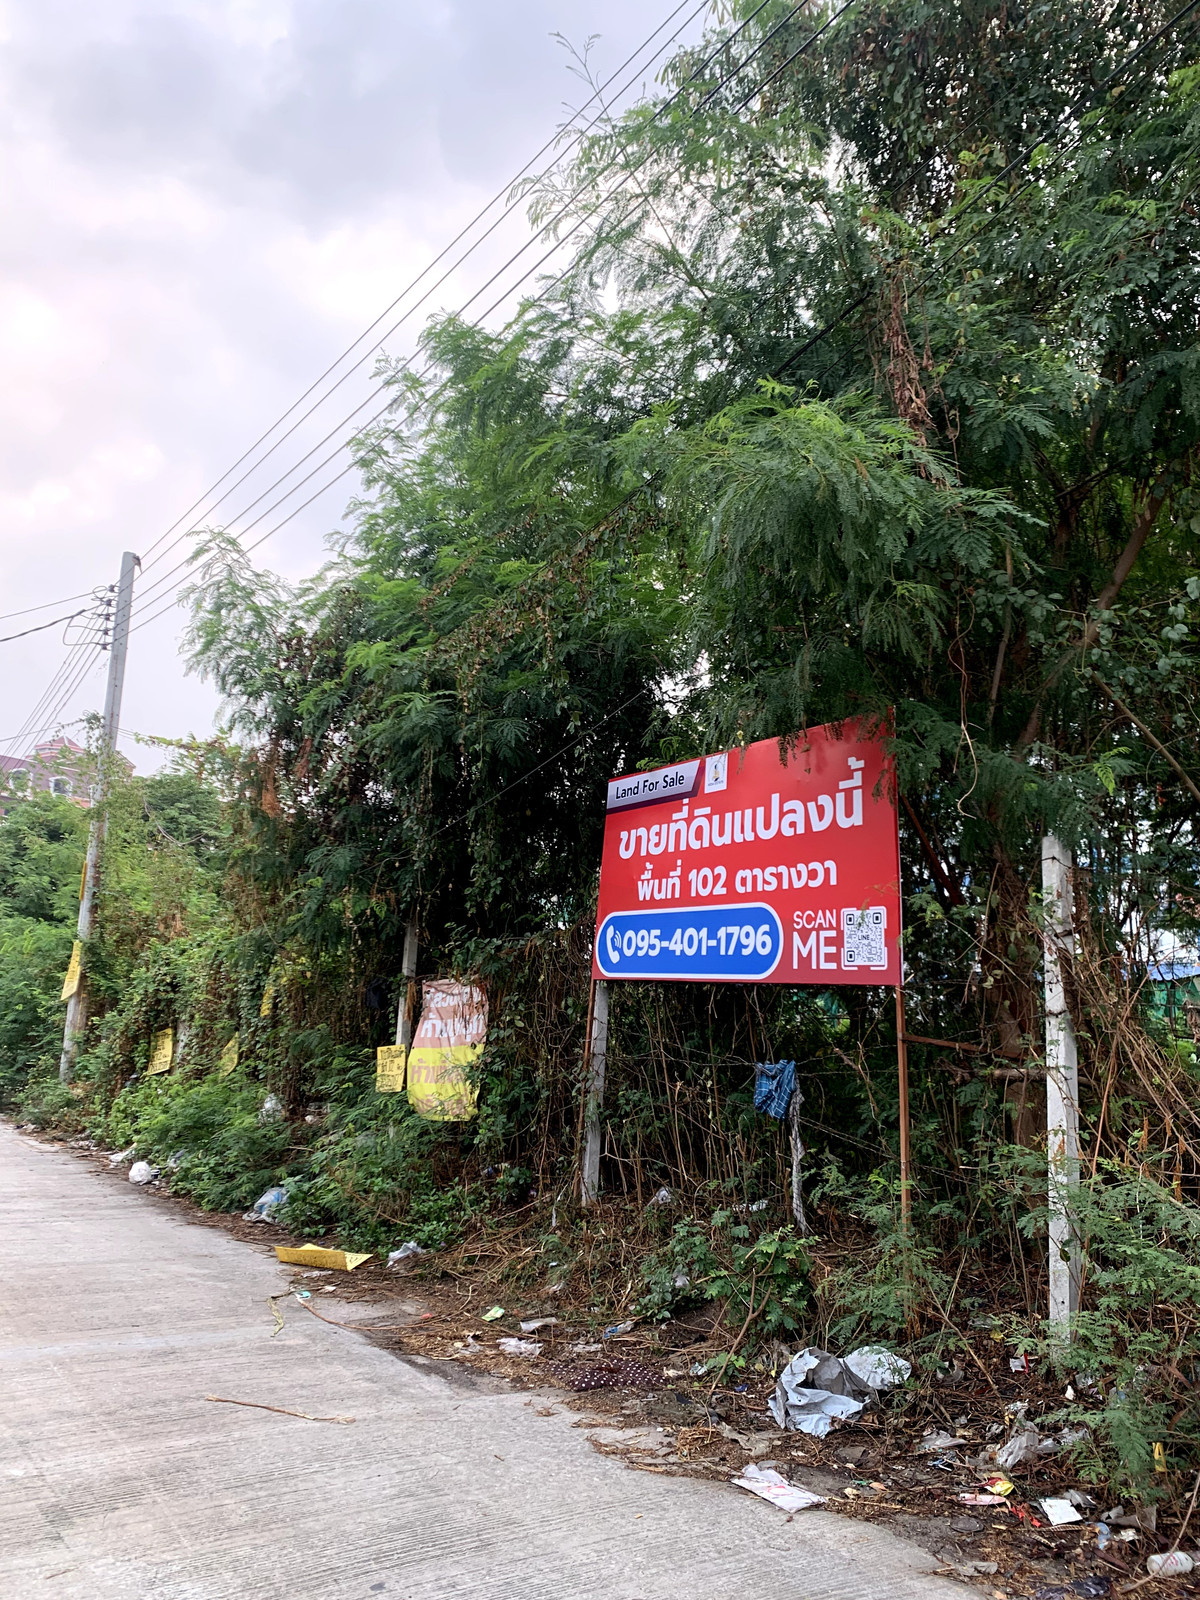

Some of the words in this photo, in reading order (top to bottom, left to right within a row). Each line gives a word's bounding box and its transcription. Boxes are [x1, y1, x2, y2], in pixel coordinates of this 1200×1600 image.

[615, 781, 640, 800] Land
[642, 779, 660, 794] For
[662, 771, 685, 789] Sale
[618, 756, 865, 860] ขายที่ดินแปลงนี้
[638, 860, 682, 901] พื้นที่
[688, 865, 727, 897] 102
[735, 860, 837, 893] ตารางวา
[793, 909, 837, 929] SCAN
[622, 924, 772, 957] 095-401-1796
[793, 931, 838, 970] ME
